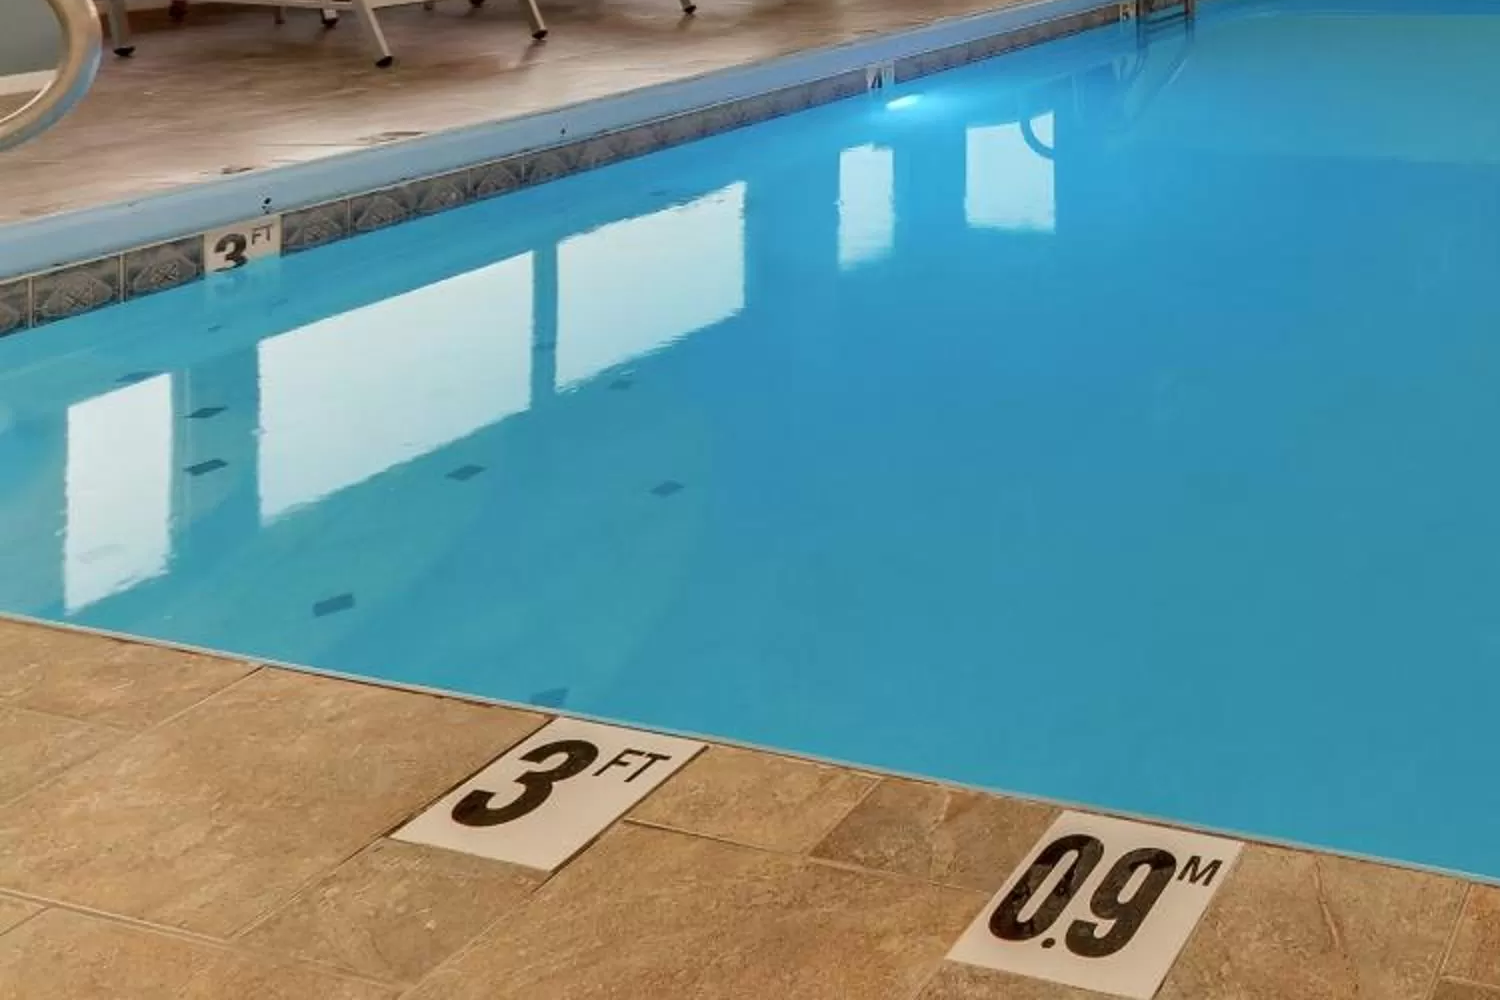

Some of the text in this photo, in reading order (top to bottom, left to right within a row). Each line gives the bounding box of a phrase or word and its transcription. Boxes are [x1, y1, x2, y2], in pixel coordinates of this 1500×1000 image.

[213, 223, 273, 273] 3 FT
[451, 739, 672, 828] 3 FT
[989, 833, 1223, 958] 0.9 M
